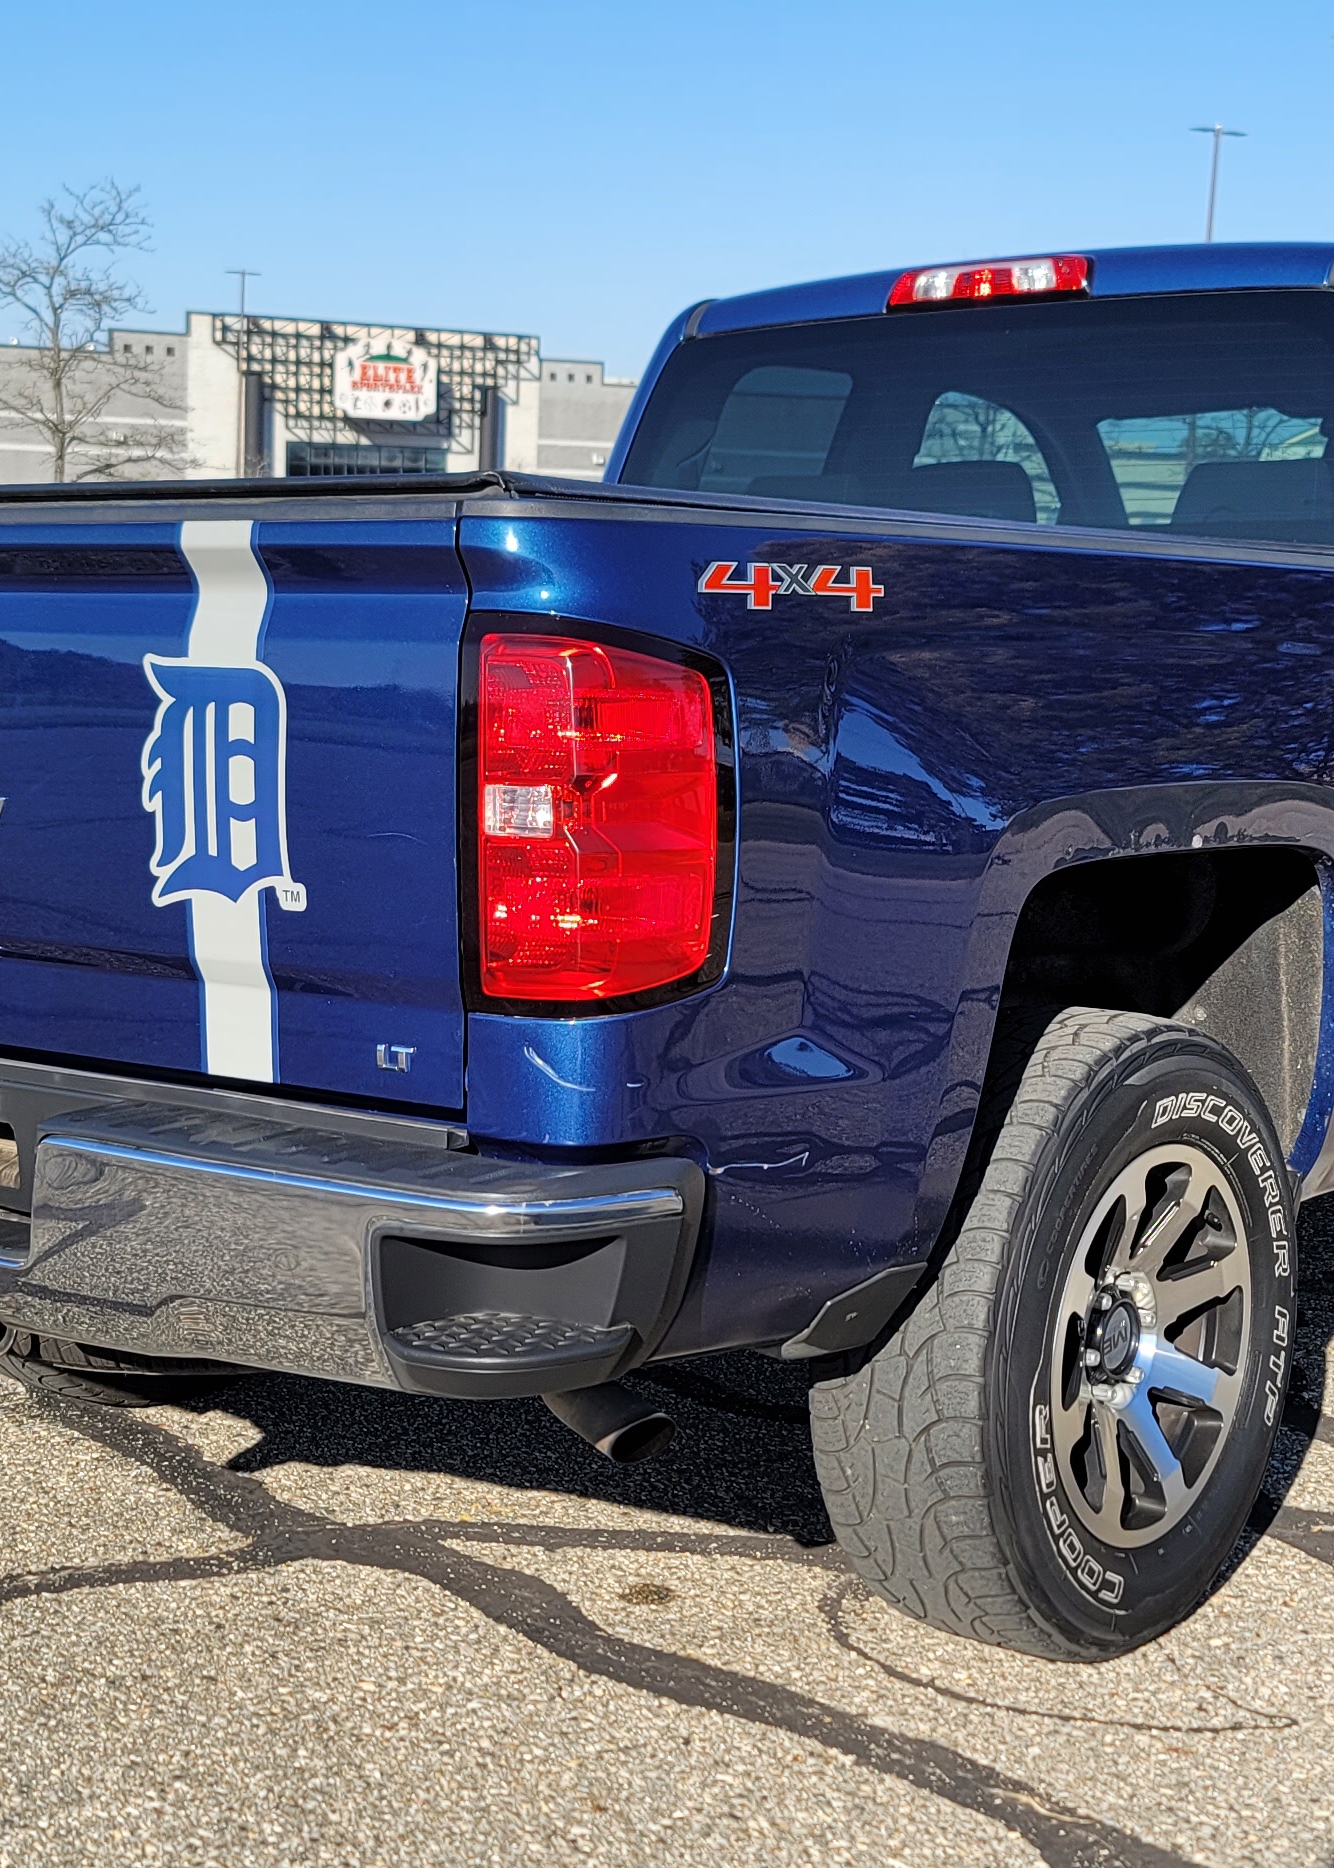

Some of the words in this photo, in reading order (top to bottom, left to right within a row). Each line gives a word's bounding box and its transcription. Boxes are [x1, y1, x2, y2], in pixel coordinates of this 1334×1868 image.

[360, 363, 414, 383] ELITE
[141, 653, 293, 908] D
[282, 890, 300, 903] TM
[376, 1043, 417, 1073] LT
[1151, 1092, 1290, 1278] DISCOVERER
[1264, 1304, 1289, 1427] ATP
[1035, 1404, 1125, 1604] COOPER
